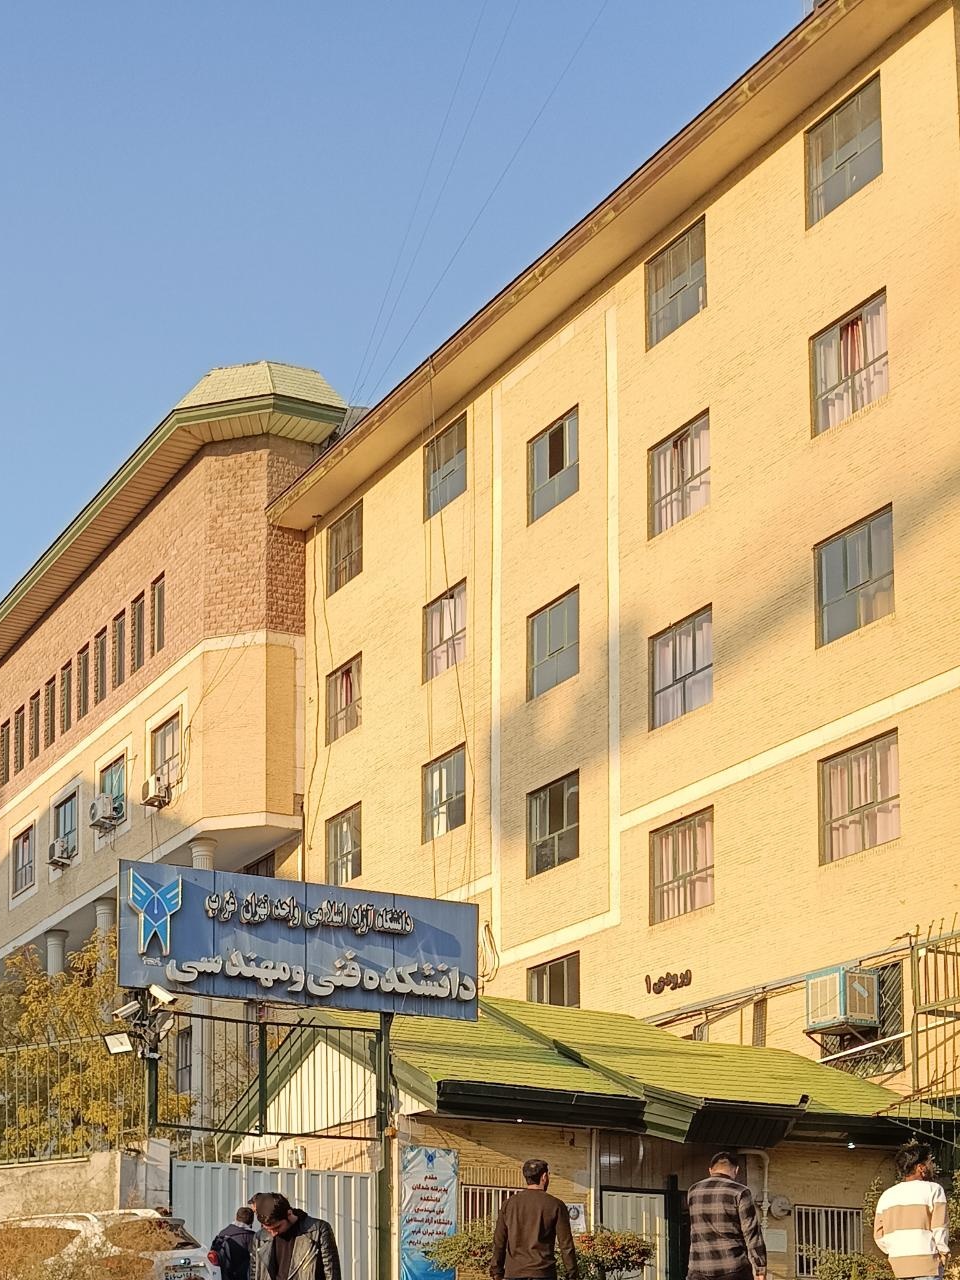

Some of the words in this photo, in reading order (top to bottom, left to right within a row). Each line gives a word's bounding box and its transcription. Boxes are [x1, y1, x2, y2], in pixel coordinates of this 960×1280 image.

[240, 891, 271, 924] تهران
[271, 895, 302, 928] واحد
[305, 899, 348, 929] اسلامی
[349, 903, 375, 936] آزاد
[374, 907, 414, 935] دانشگاه
[306, 949, 361, 997] فنی
[363, 961, 477, 1001] دانشکده
[652, 969, 692, 994] ورودی
